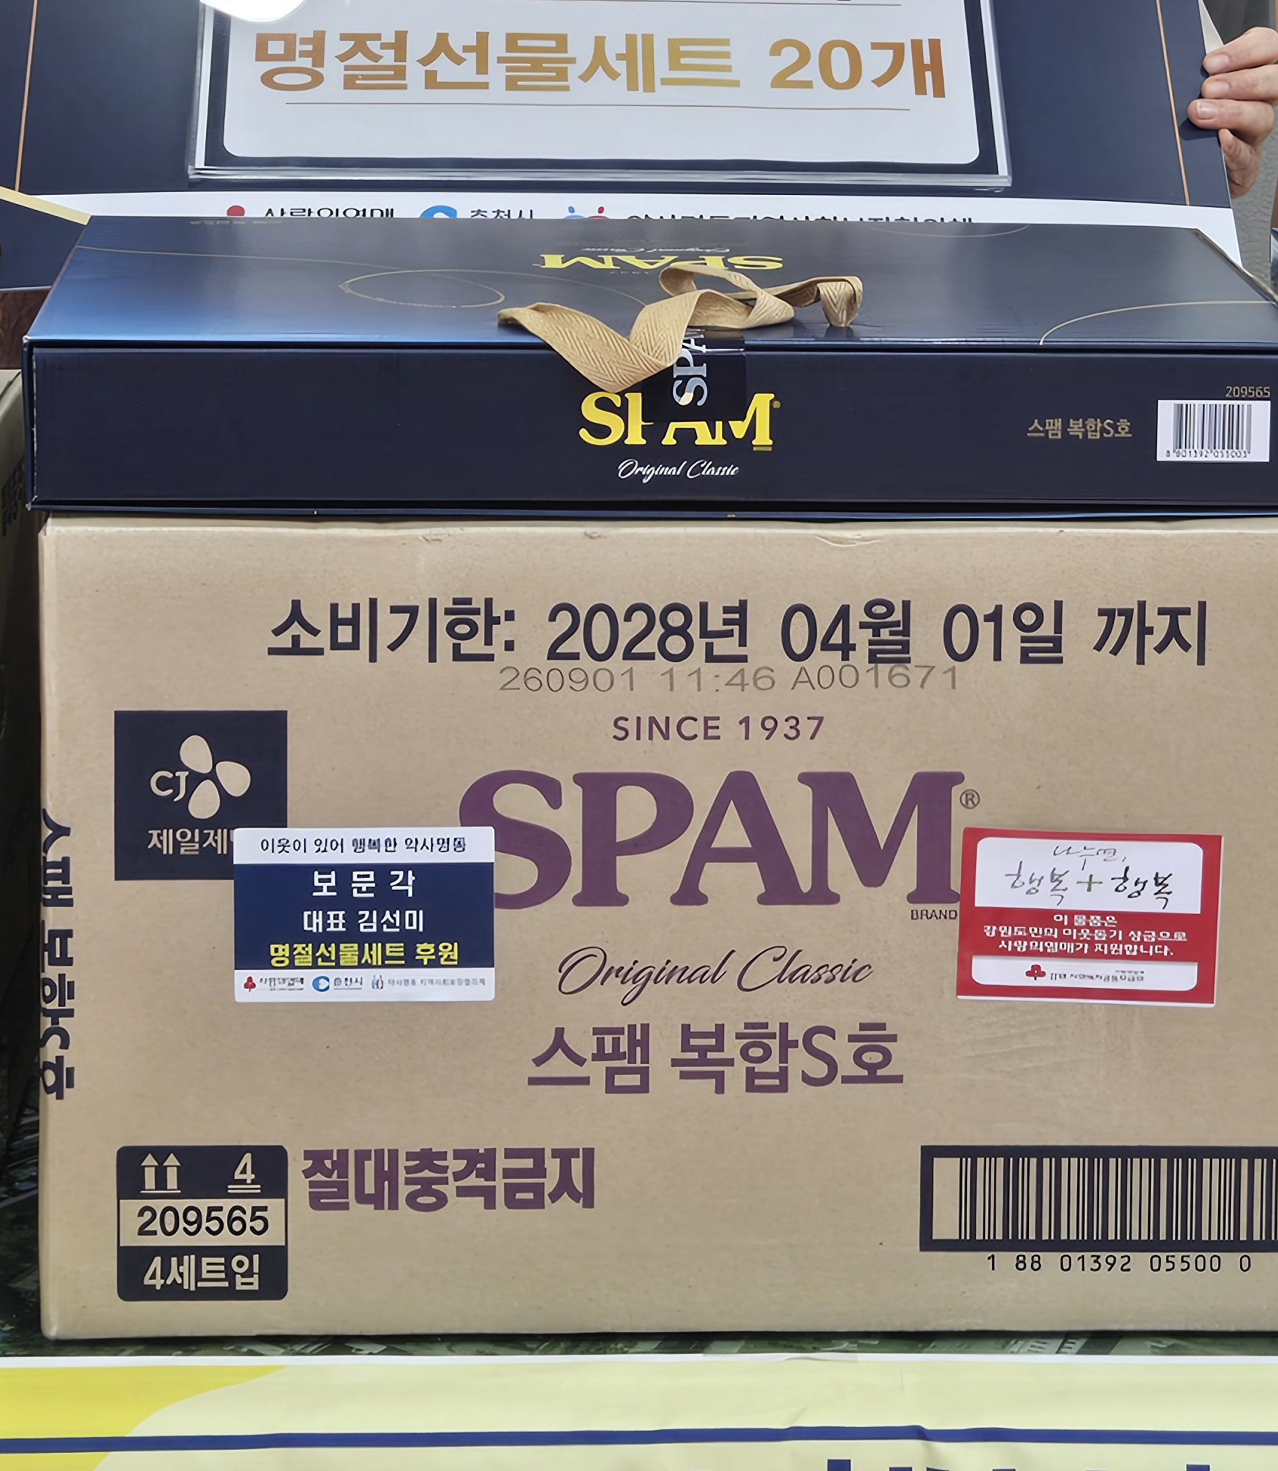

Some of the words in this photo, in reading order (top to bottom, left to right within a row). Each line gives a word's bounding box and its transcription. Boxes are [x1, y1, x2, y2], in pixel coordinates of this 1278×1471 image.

[253, 29, 742, 95] 명절선물세트
[769, 35, 947, 101] 20개
[1225, 386, 1271, 398] 209565
[1026, 418, 1063, 440] 스팸
[1066, 418, 1133, 440] 복합S호
[616, 458, 687, 484] Original
[686, 458, 740, 478] Classic
[267, 599, 517, 664] 소비기한:
[547, 600, 751, 665] 2028년
[779, 601, 913, 667] 04월
[941, 601, 1066, 667] 01일
[1094, 599, 1210, 667] 까지
[499, 665, 637, 692] 260901
[657, 665, 778, 692] 11:46
[790, 665, 962, 692] A001671
[612, 716, 725, 742] SINCE
[738, 716, 825, 742] 1937
[149, 769, 190, 802] CJ
[260, 837, 308, 855] 이웃이
[313, 838, 345, 854] 있어
[352, 837, 398, 854] 행복한
[403, 836, 467, 853] 약사명동
[458, 769, 963, 909] SPAM
[302, 909, 347, 933] 대표
[357, 909, 425, 933] 김선미
[909, 909, 958, 921] BRAND
[269, 941, 405, 967] 명절선물세트
[414, 941, 460, 966] 후원
[558, 947, 734, 1010] Original
[729, 944, 873, 994] Classic
[526, 1024, 653, 1095] 스팸
[669, 1023, 906, 1096] 복합S호
[232, 1151, 256, 1185] 4
[301, 1145, 597, 1212] 절대충격금지
[135, 1203, 271, 1238] 209565
[142, 1253, 261, 1293] 4세트입
[987, 1253, 998, 1272] 1
[1014, 1253, 1044, 1272] 88
[1059, 1253, 1132, 1272] 01392
[1149, 1253, 1223, 1272] 05500
[1239, 1253, 1253, 1272] 0
